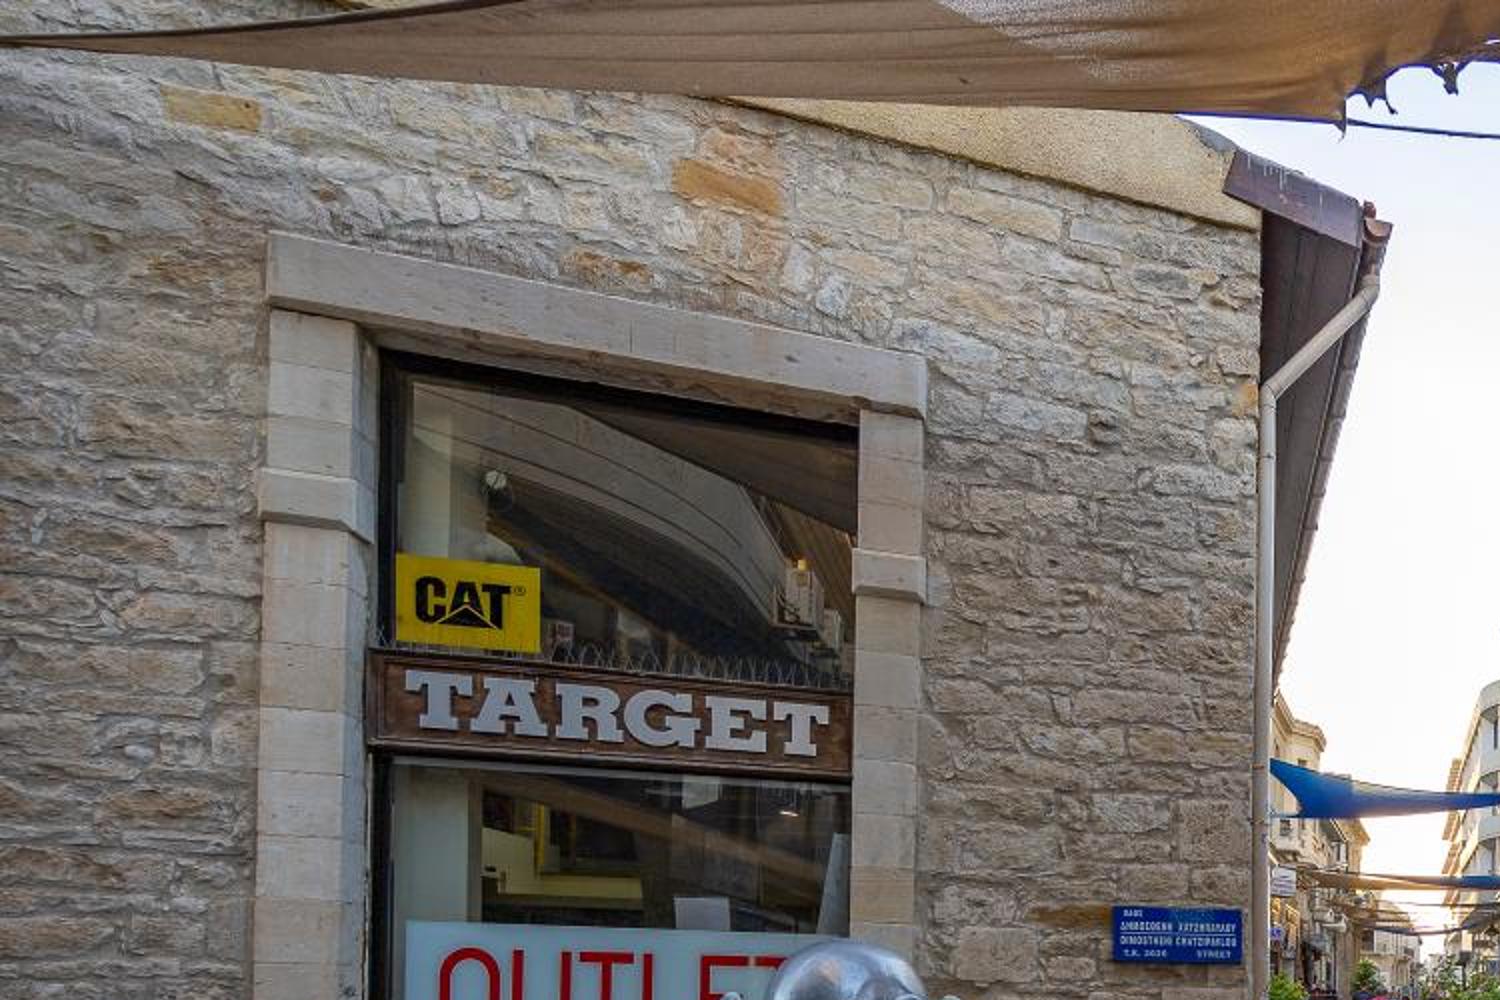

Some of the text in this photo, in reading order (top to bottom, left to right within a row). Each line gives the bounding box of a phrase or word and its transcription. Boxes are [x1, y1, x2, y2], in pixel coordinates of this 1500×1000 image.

[415, 575, 512, 631] CAT
[405, 669, 829, 757] TARGET
[1196, 950, 1231, 959] STREET
